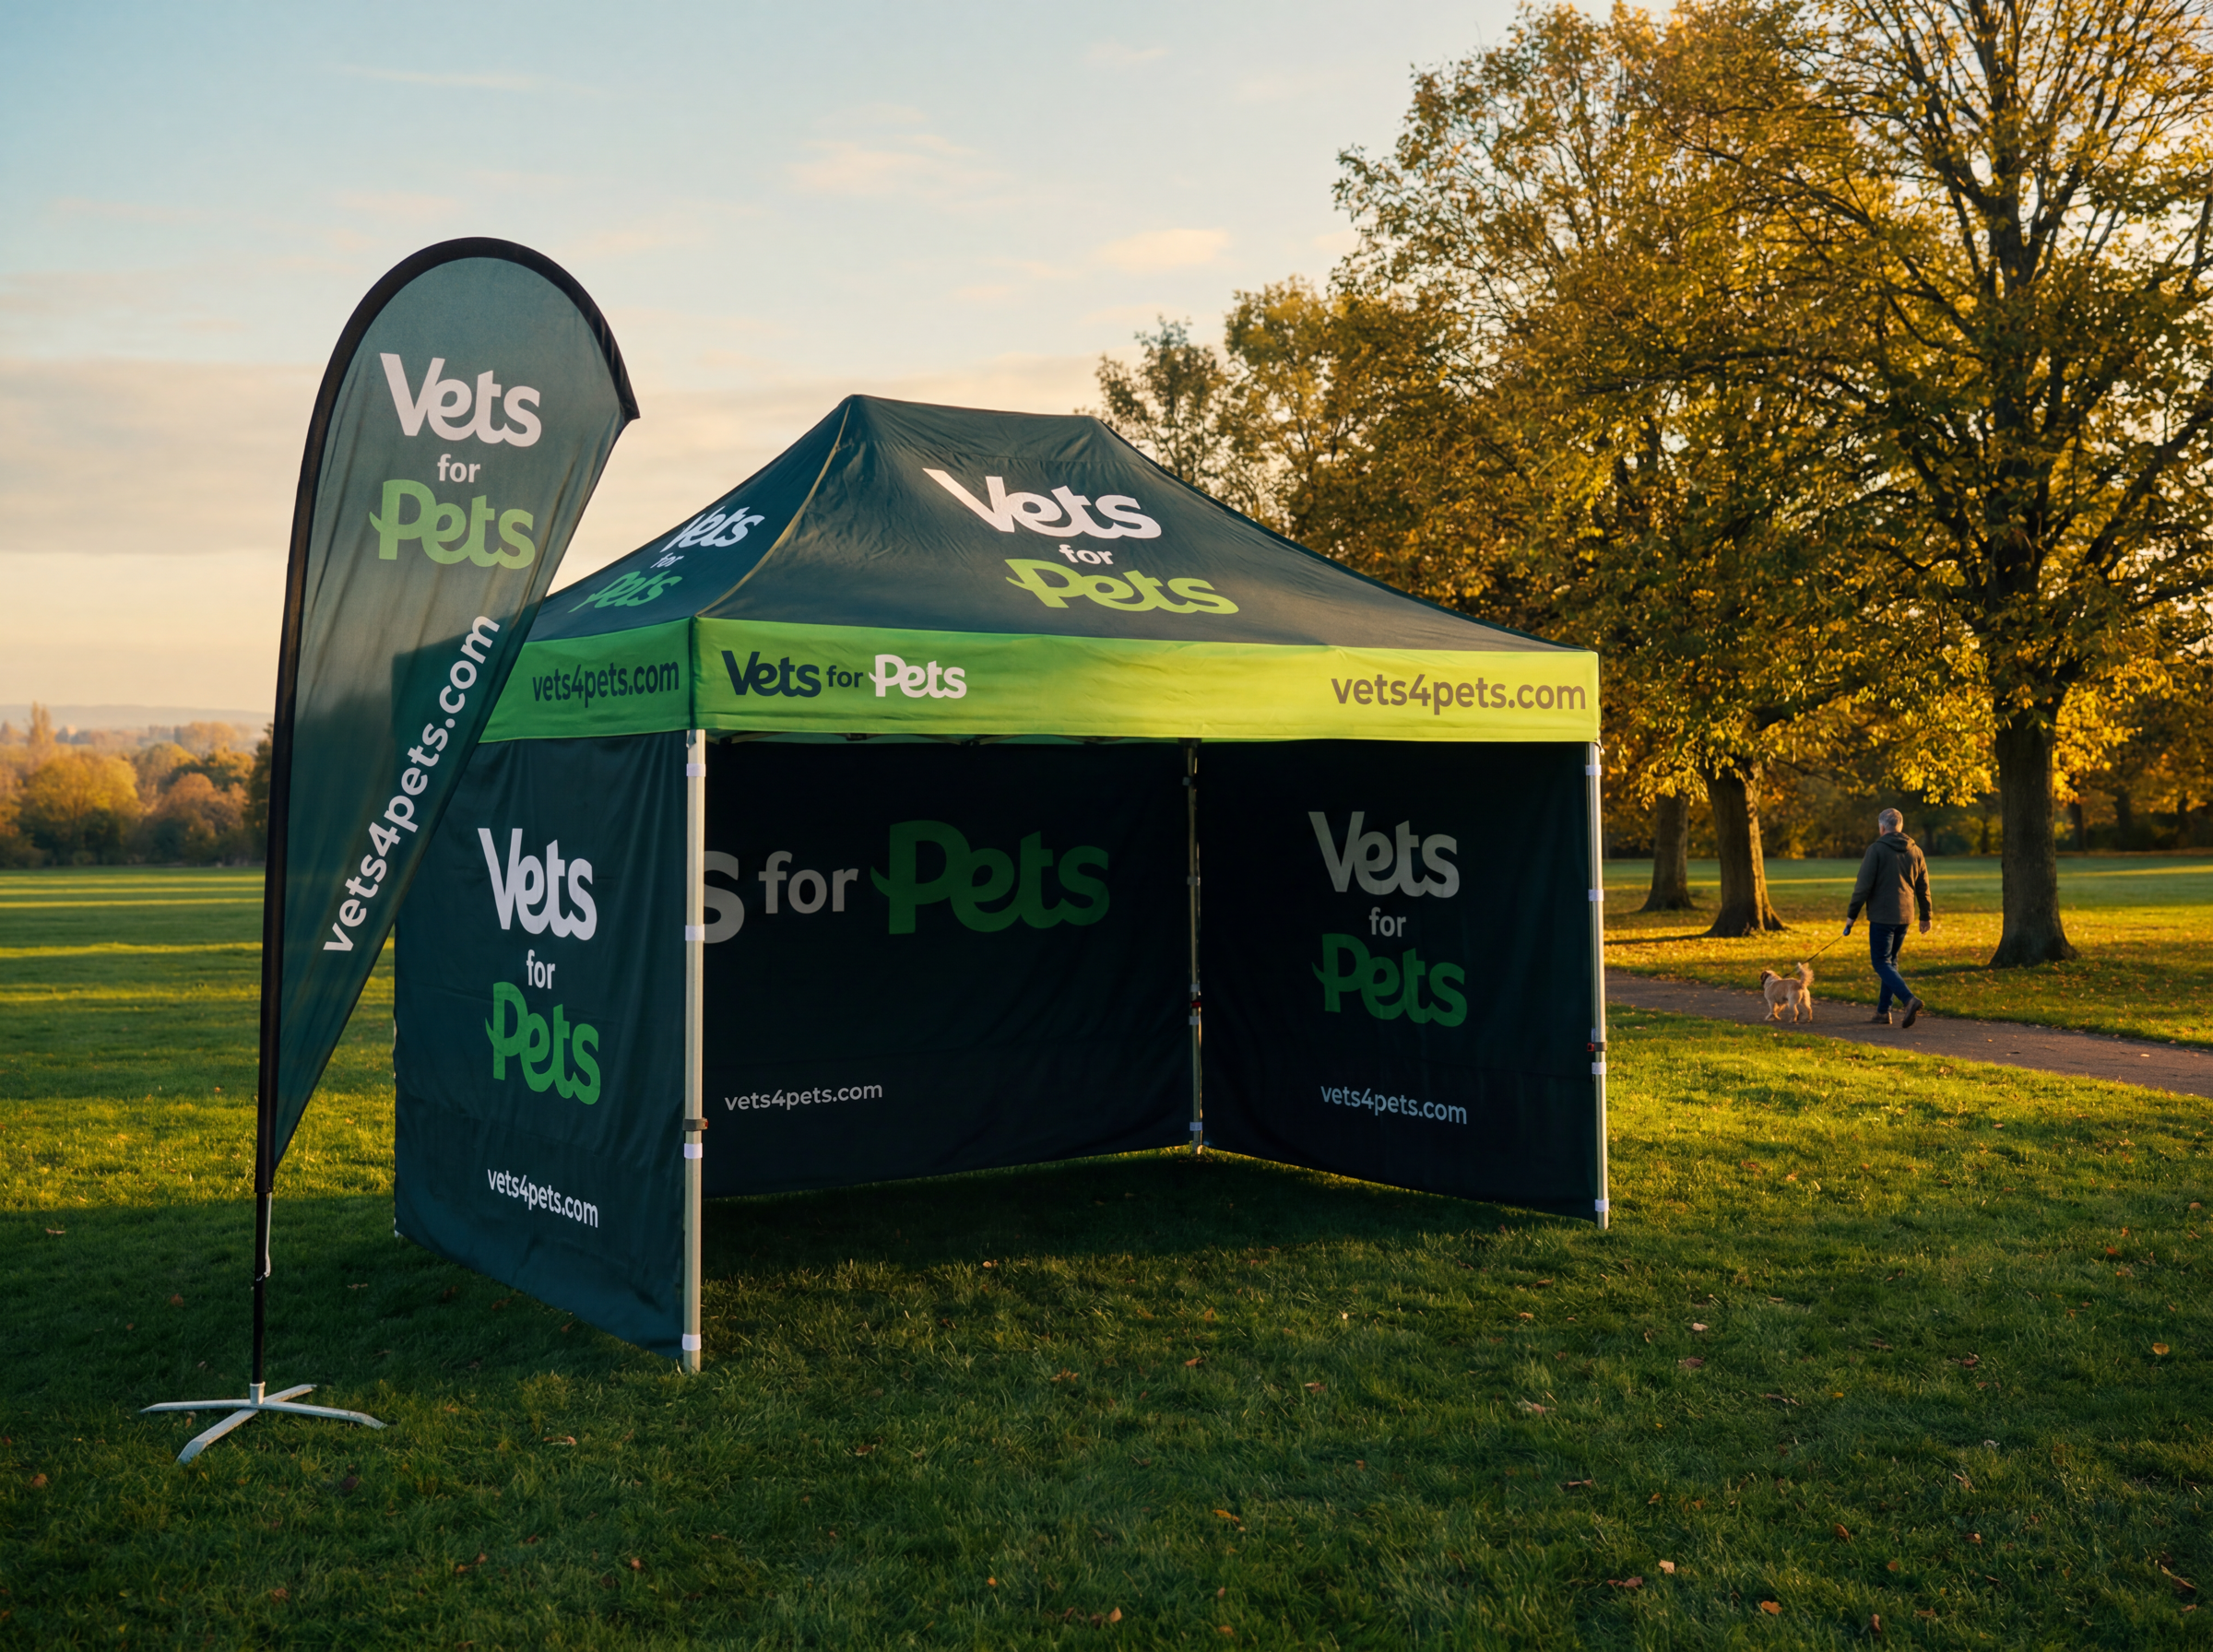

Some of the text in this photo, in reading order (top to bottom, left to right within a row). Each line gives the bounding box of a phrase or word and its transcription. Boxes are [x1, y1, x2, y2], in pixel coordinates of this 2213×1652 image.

[380, 352, 541, 447] Vets
[437, 454, 480, 483] for
[369, 479, 536, 570] Pets
[922, 468, 1162, 539] Vets
[659, 505, 765, 553] Vets
[650, 552, 684, 569] for
[1059, 544, 1114, 565] for
[567, 570, 682, 613] Pets
[1004, 559, 1239, 615] Pets
[532, 661, 679, 708] vets4pets.com
[721, 650, 967, 699] Vets for Pets
[1331, 673, 1586, 715] vets4pets.com
[323, 616, 500, 951] vets4pets.com
[758, 850, 858, 914] for
[870, 820, 1110, 935] Pets
[1308, 811, 1461, 899] Vets
[477, 828, 597, 941] Vets
[1369, 907, 1406, 938] for
[526, 950, 555, 989] for
[1311, 933, 1468, 1028] Pets
[485, 981, 601, 1105] Pets
[724, 1083, 882, 1111] vets4pets.com
[1320, 1086, 1468, 1125] vets4pets.com
[487, 1169, 598, 1228] vets4pets.com
